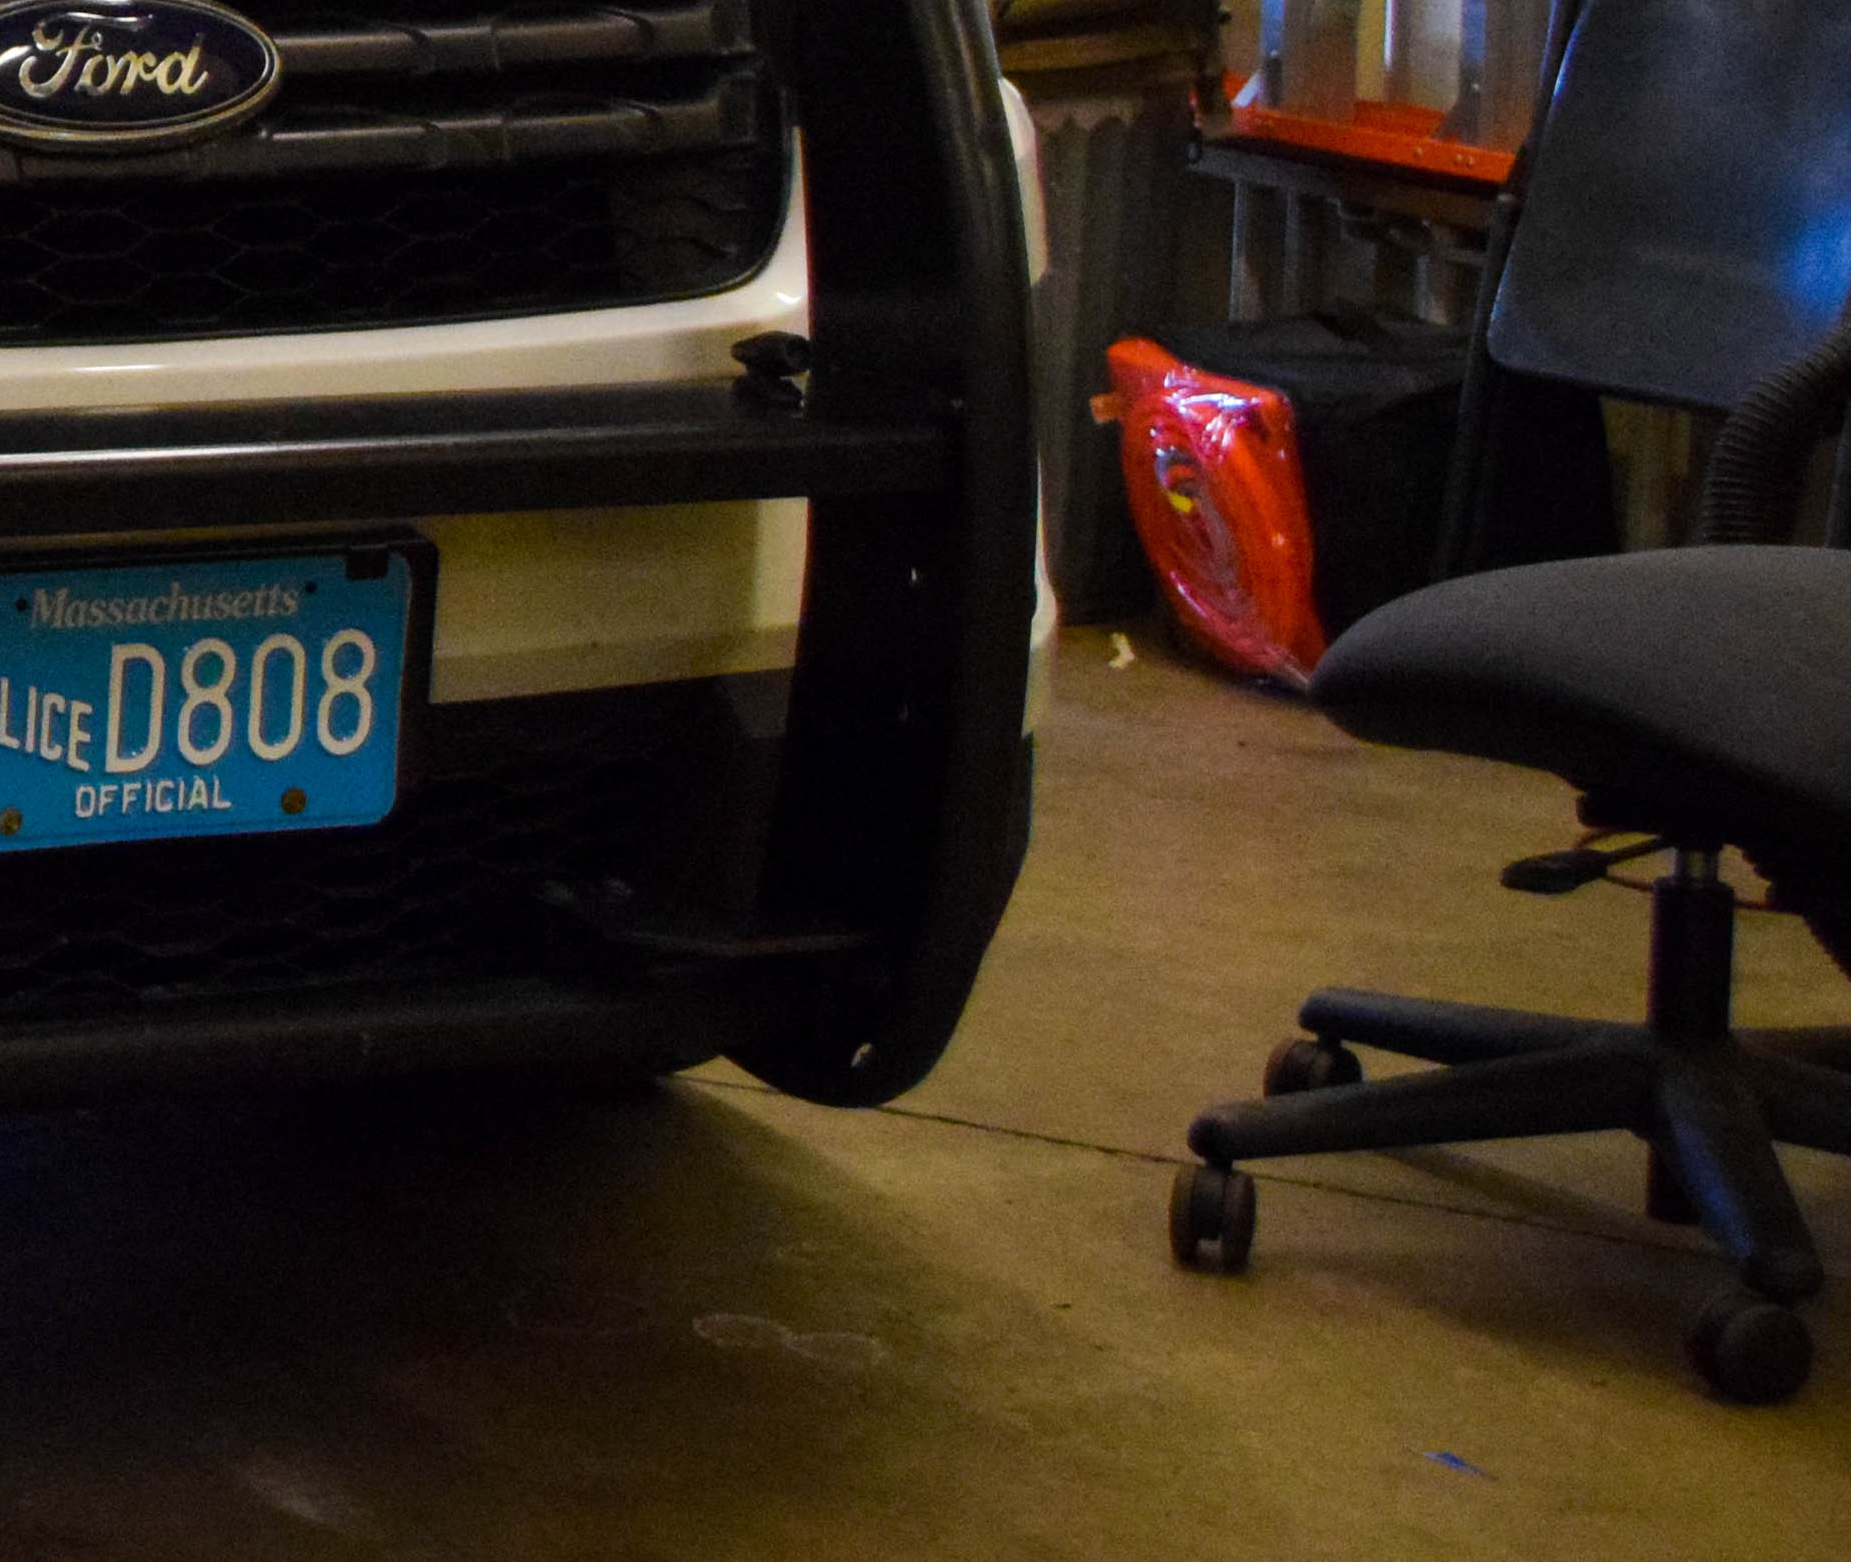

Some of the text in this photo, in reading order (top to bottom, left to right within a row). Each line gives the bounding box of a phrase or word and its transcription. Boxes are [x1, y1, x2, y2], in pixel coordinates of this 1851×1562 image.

[19, 11, 210, 98] Ford
[30, 581, 302, 630] Massachusetts
[105, 628, 376, 775] D808
[74, 775, 233, 819] OFFICIAL
